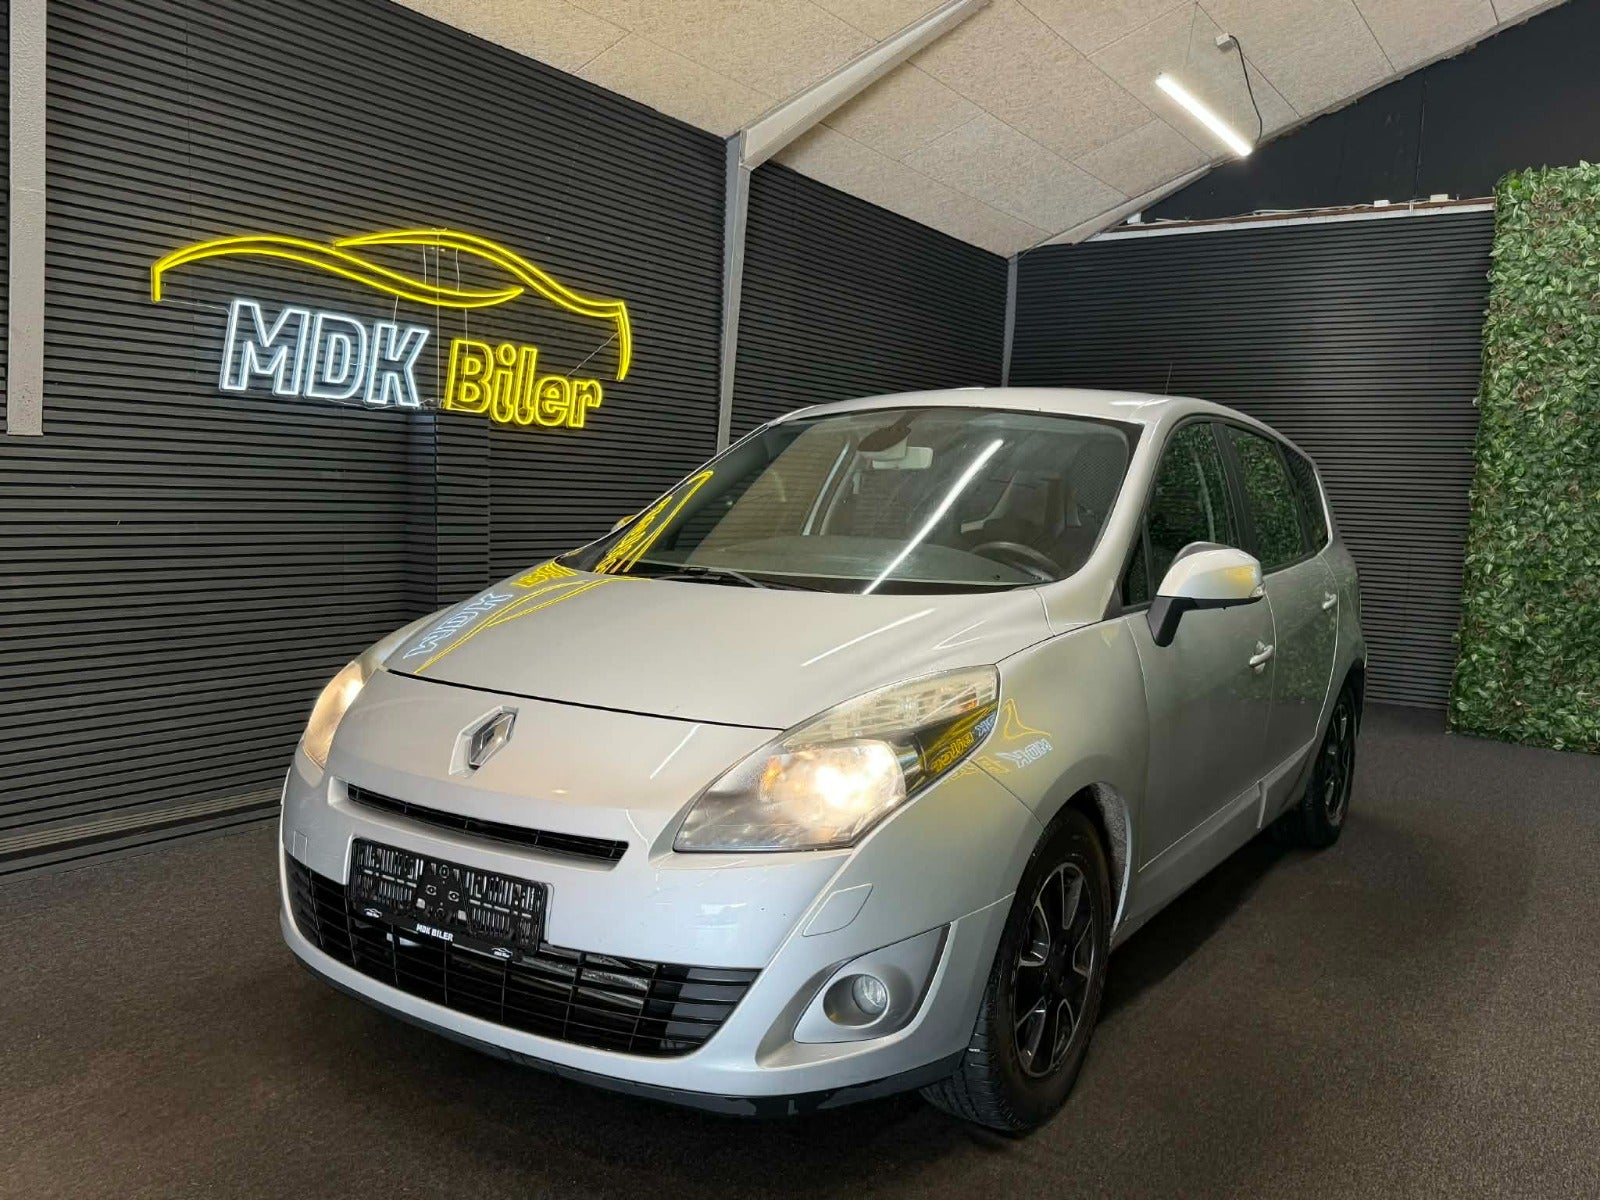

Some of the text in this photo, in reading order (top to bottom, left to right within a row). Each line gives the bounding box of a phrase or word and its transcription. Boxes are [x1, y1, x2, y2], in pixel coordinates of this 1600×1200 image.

[219, 299, 603, 429] MDK Biler
[416, 923, 454, 942] MDK BILER
